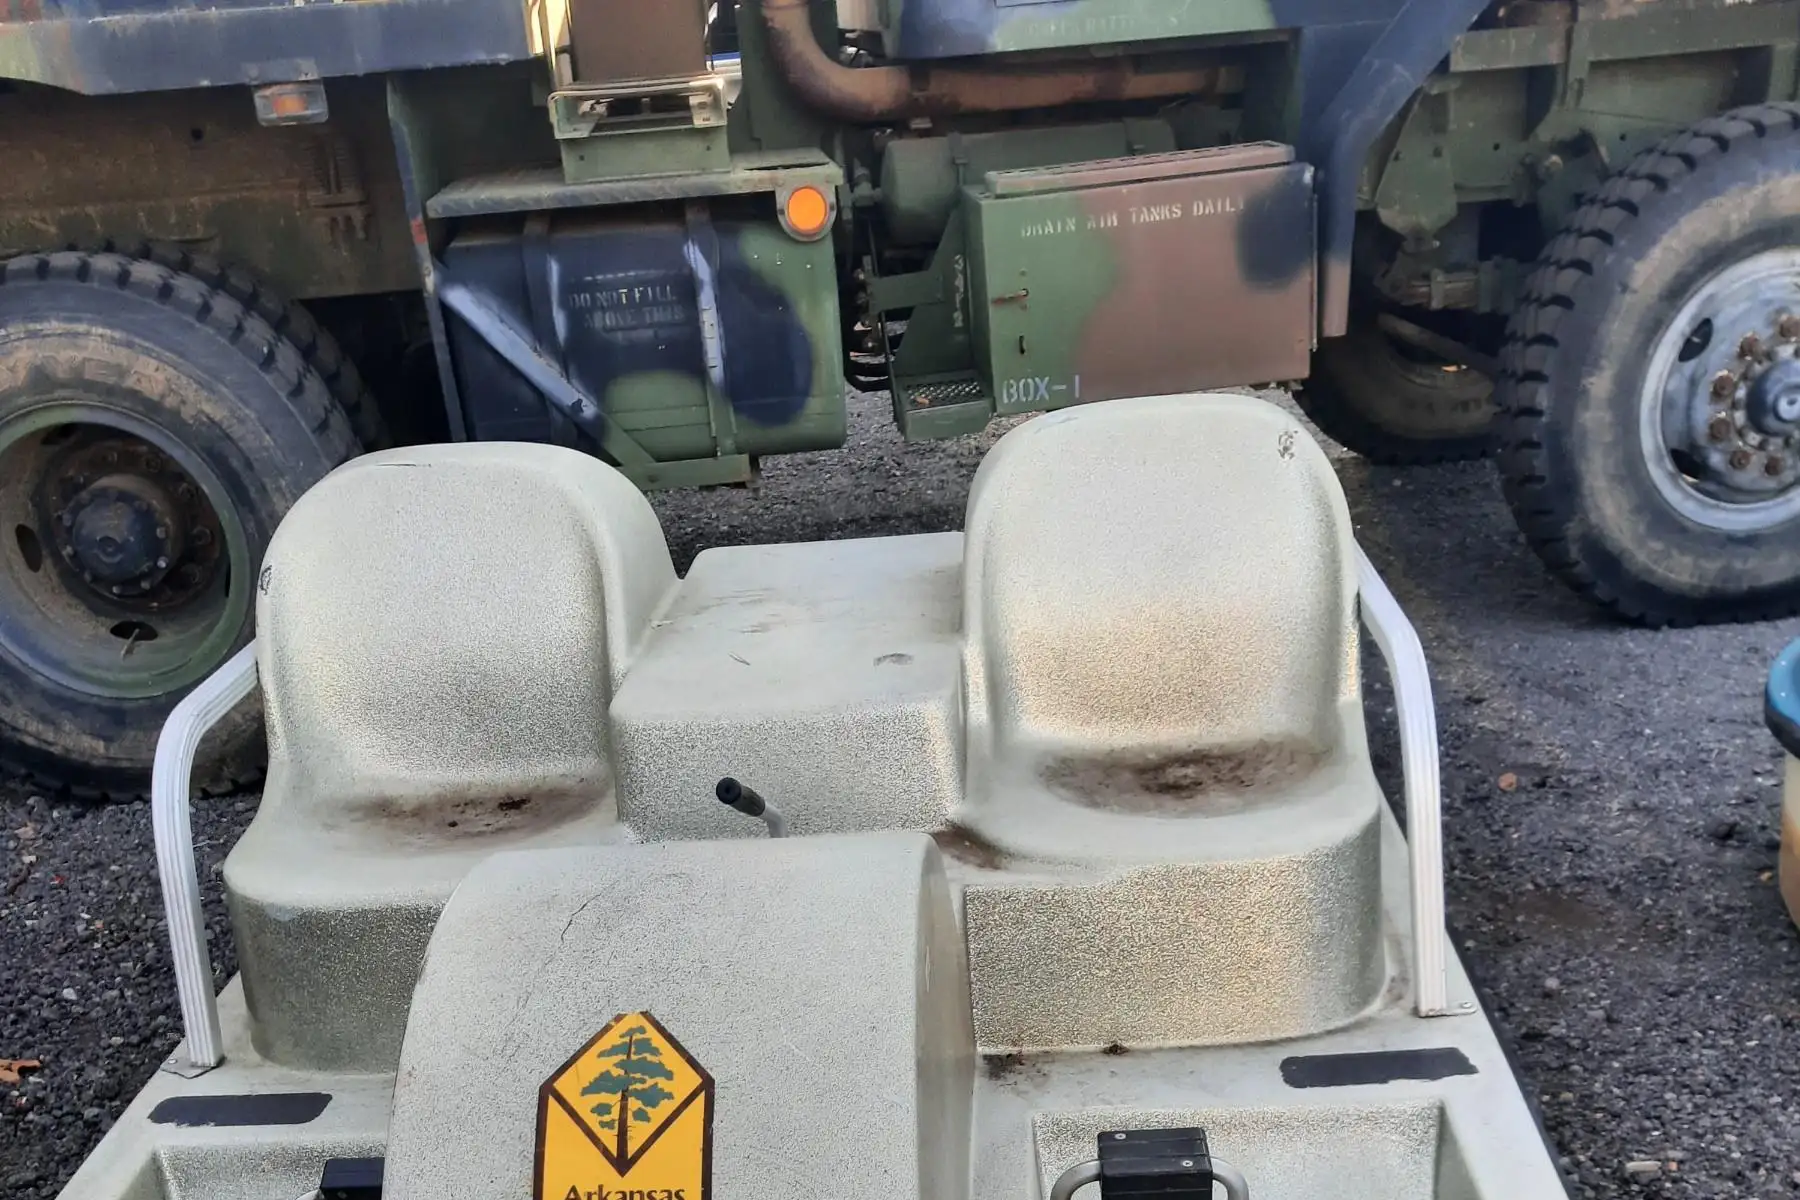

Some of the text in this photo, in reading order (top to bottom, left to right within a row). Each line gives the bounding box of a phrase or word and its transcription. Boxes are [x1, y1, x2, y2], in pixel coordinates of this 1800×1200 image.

[1020, 215, 1077, 238] DRAIN
[1086, 210, 1120, 230] AIR
[1129, 202, 1183, 224] TANKS
[568, 283, 676, 309] DO NOT FILL
